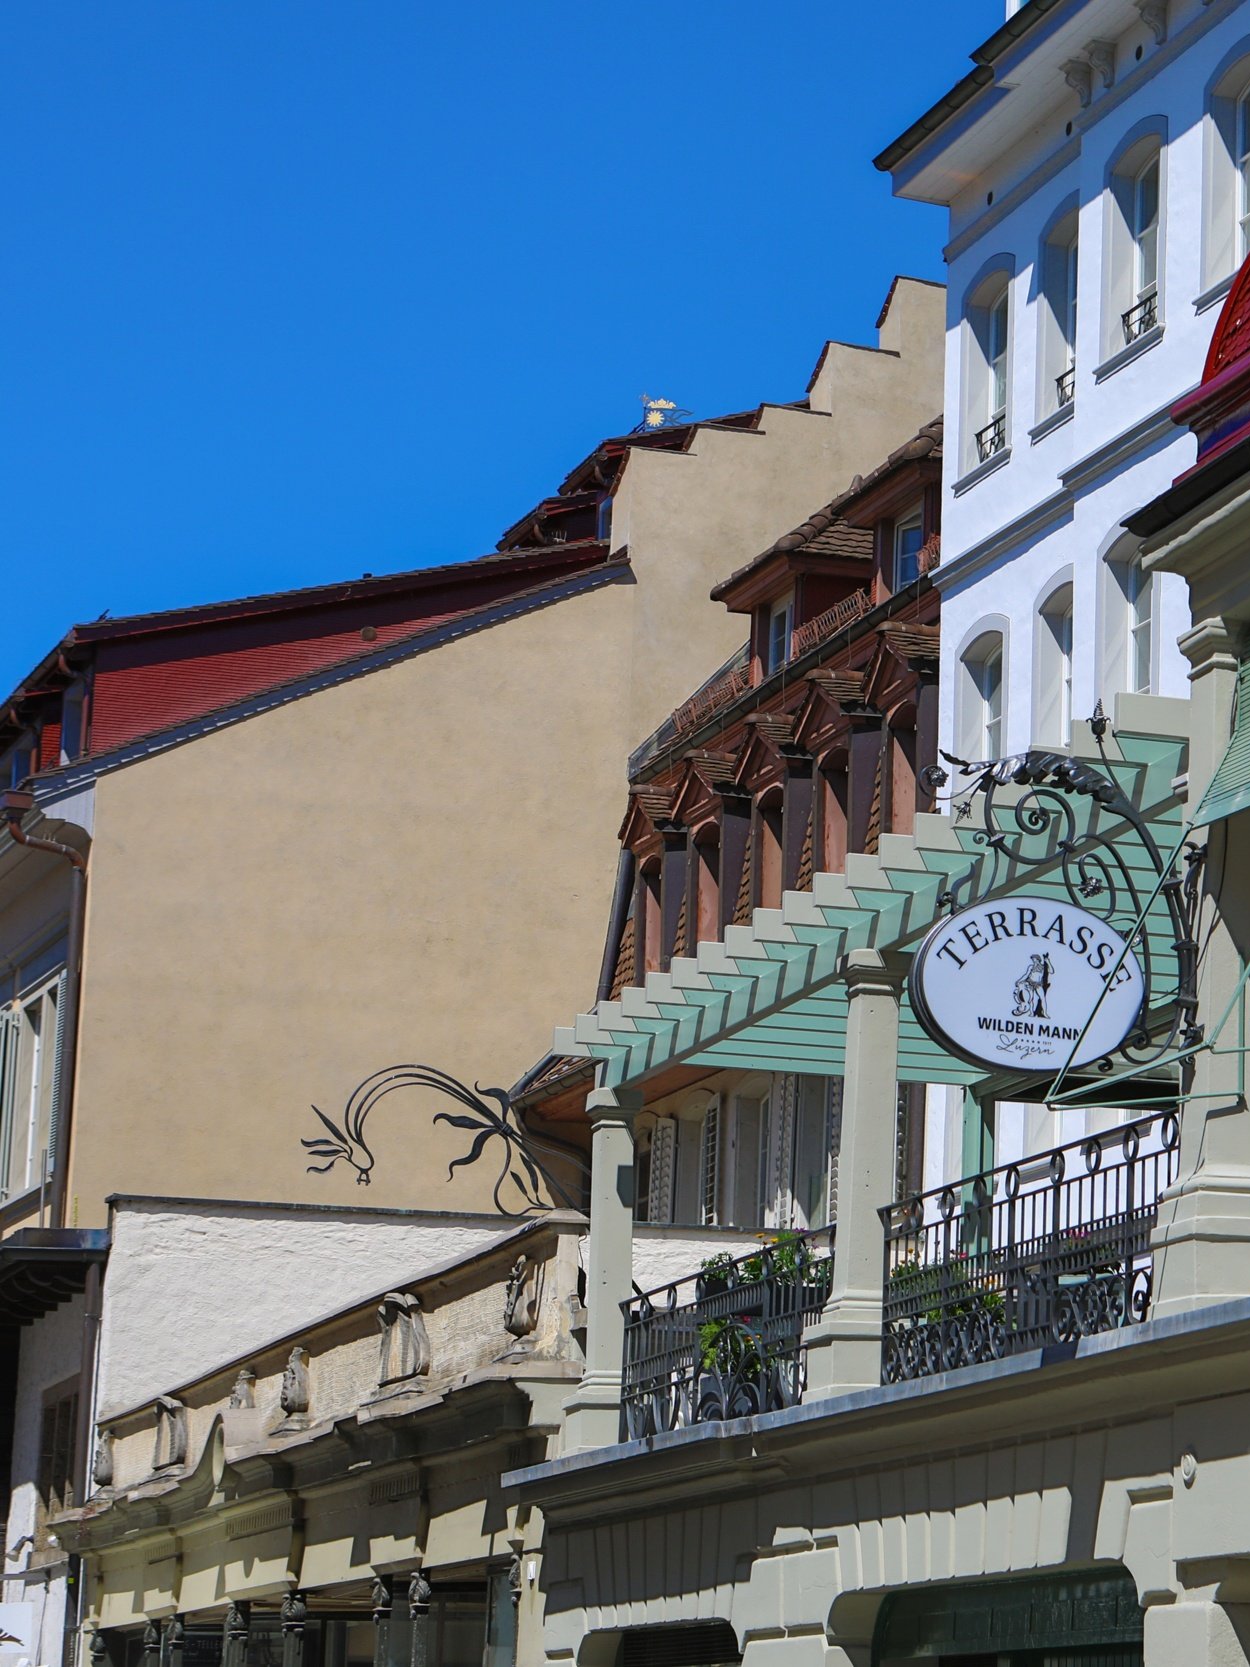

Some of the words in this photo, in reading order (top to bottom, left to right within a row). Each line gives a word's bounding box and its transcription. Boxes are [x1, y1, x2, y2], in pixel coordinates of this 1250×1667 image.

[936, 907, 1132, 992] TERRASSE
[977, 1016, 1034, 1036] WILDEN
[1038, 1024, 1082, 1041] MANN
[996, 1034, 1055, 1059] Luzern
